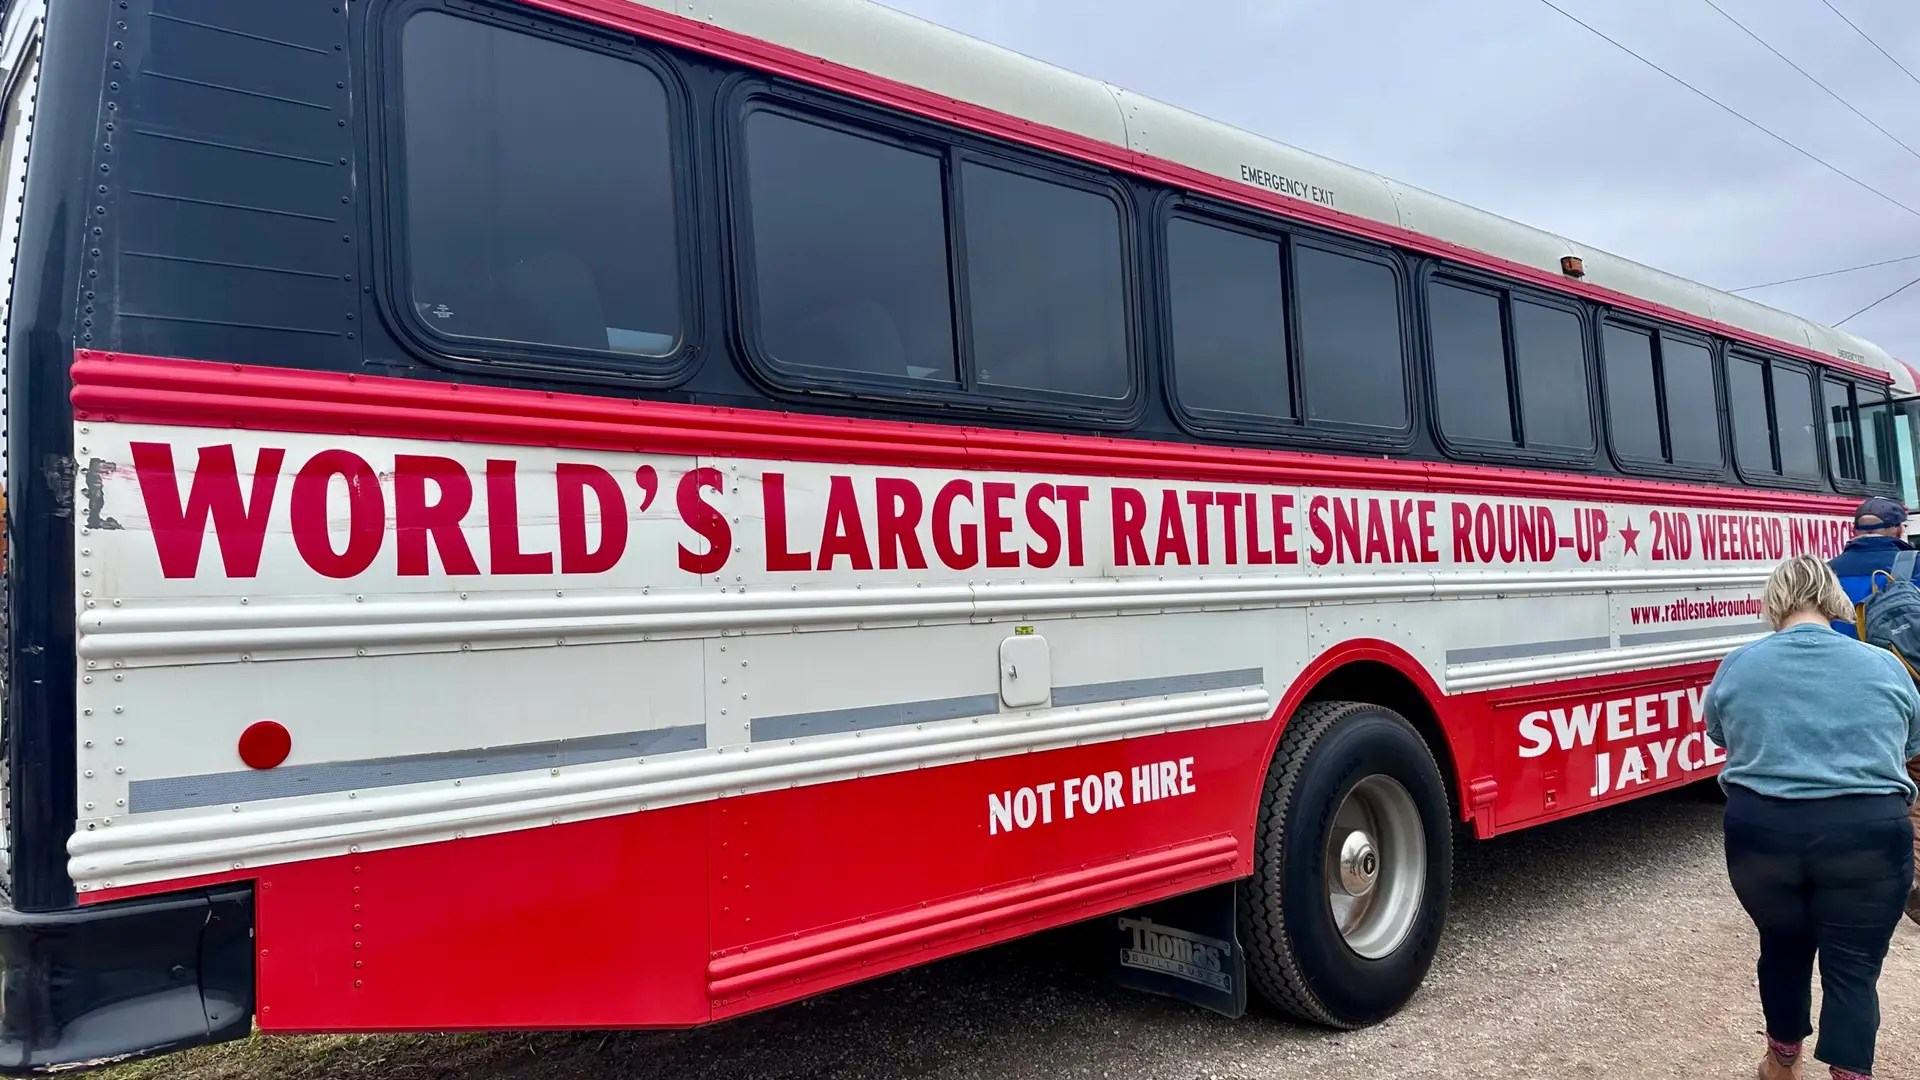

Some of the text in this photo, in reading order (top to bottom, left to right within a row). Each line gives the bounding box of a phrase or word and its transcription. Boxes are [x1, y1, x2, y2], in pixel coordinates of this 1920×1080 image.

[1240, 164, 1334, 206] EMERGENCY EXIT
[130, 441, 732, 578] WORLD'S
[762, 472, 1089, 571] LARGEST
[1111, 487, 1298, 566] RATTLE
[1309, 495, 1439, 566] SNAKE
[1451, 502, 1608, 563] ROUND-UP
[1649, 510, 1692, 560] 2ND
[1697, 514, 1783, 560] WEEKEND
[1789, 518, 1805, 557] IN
[988, 757, 1196, 835] NOT FOR HIRE
[1119, 916, 1231, 972] Thomas
[1132, 953, 1171, 969] BUILT
